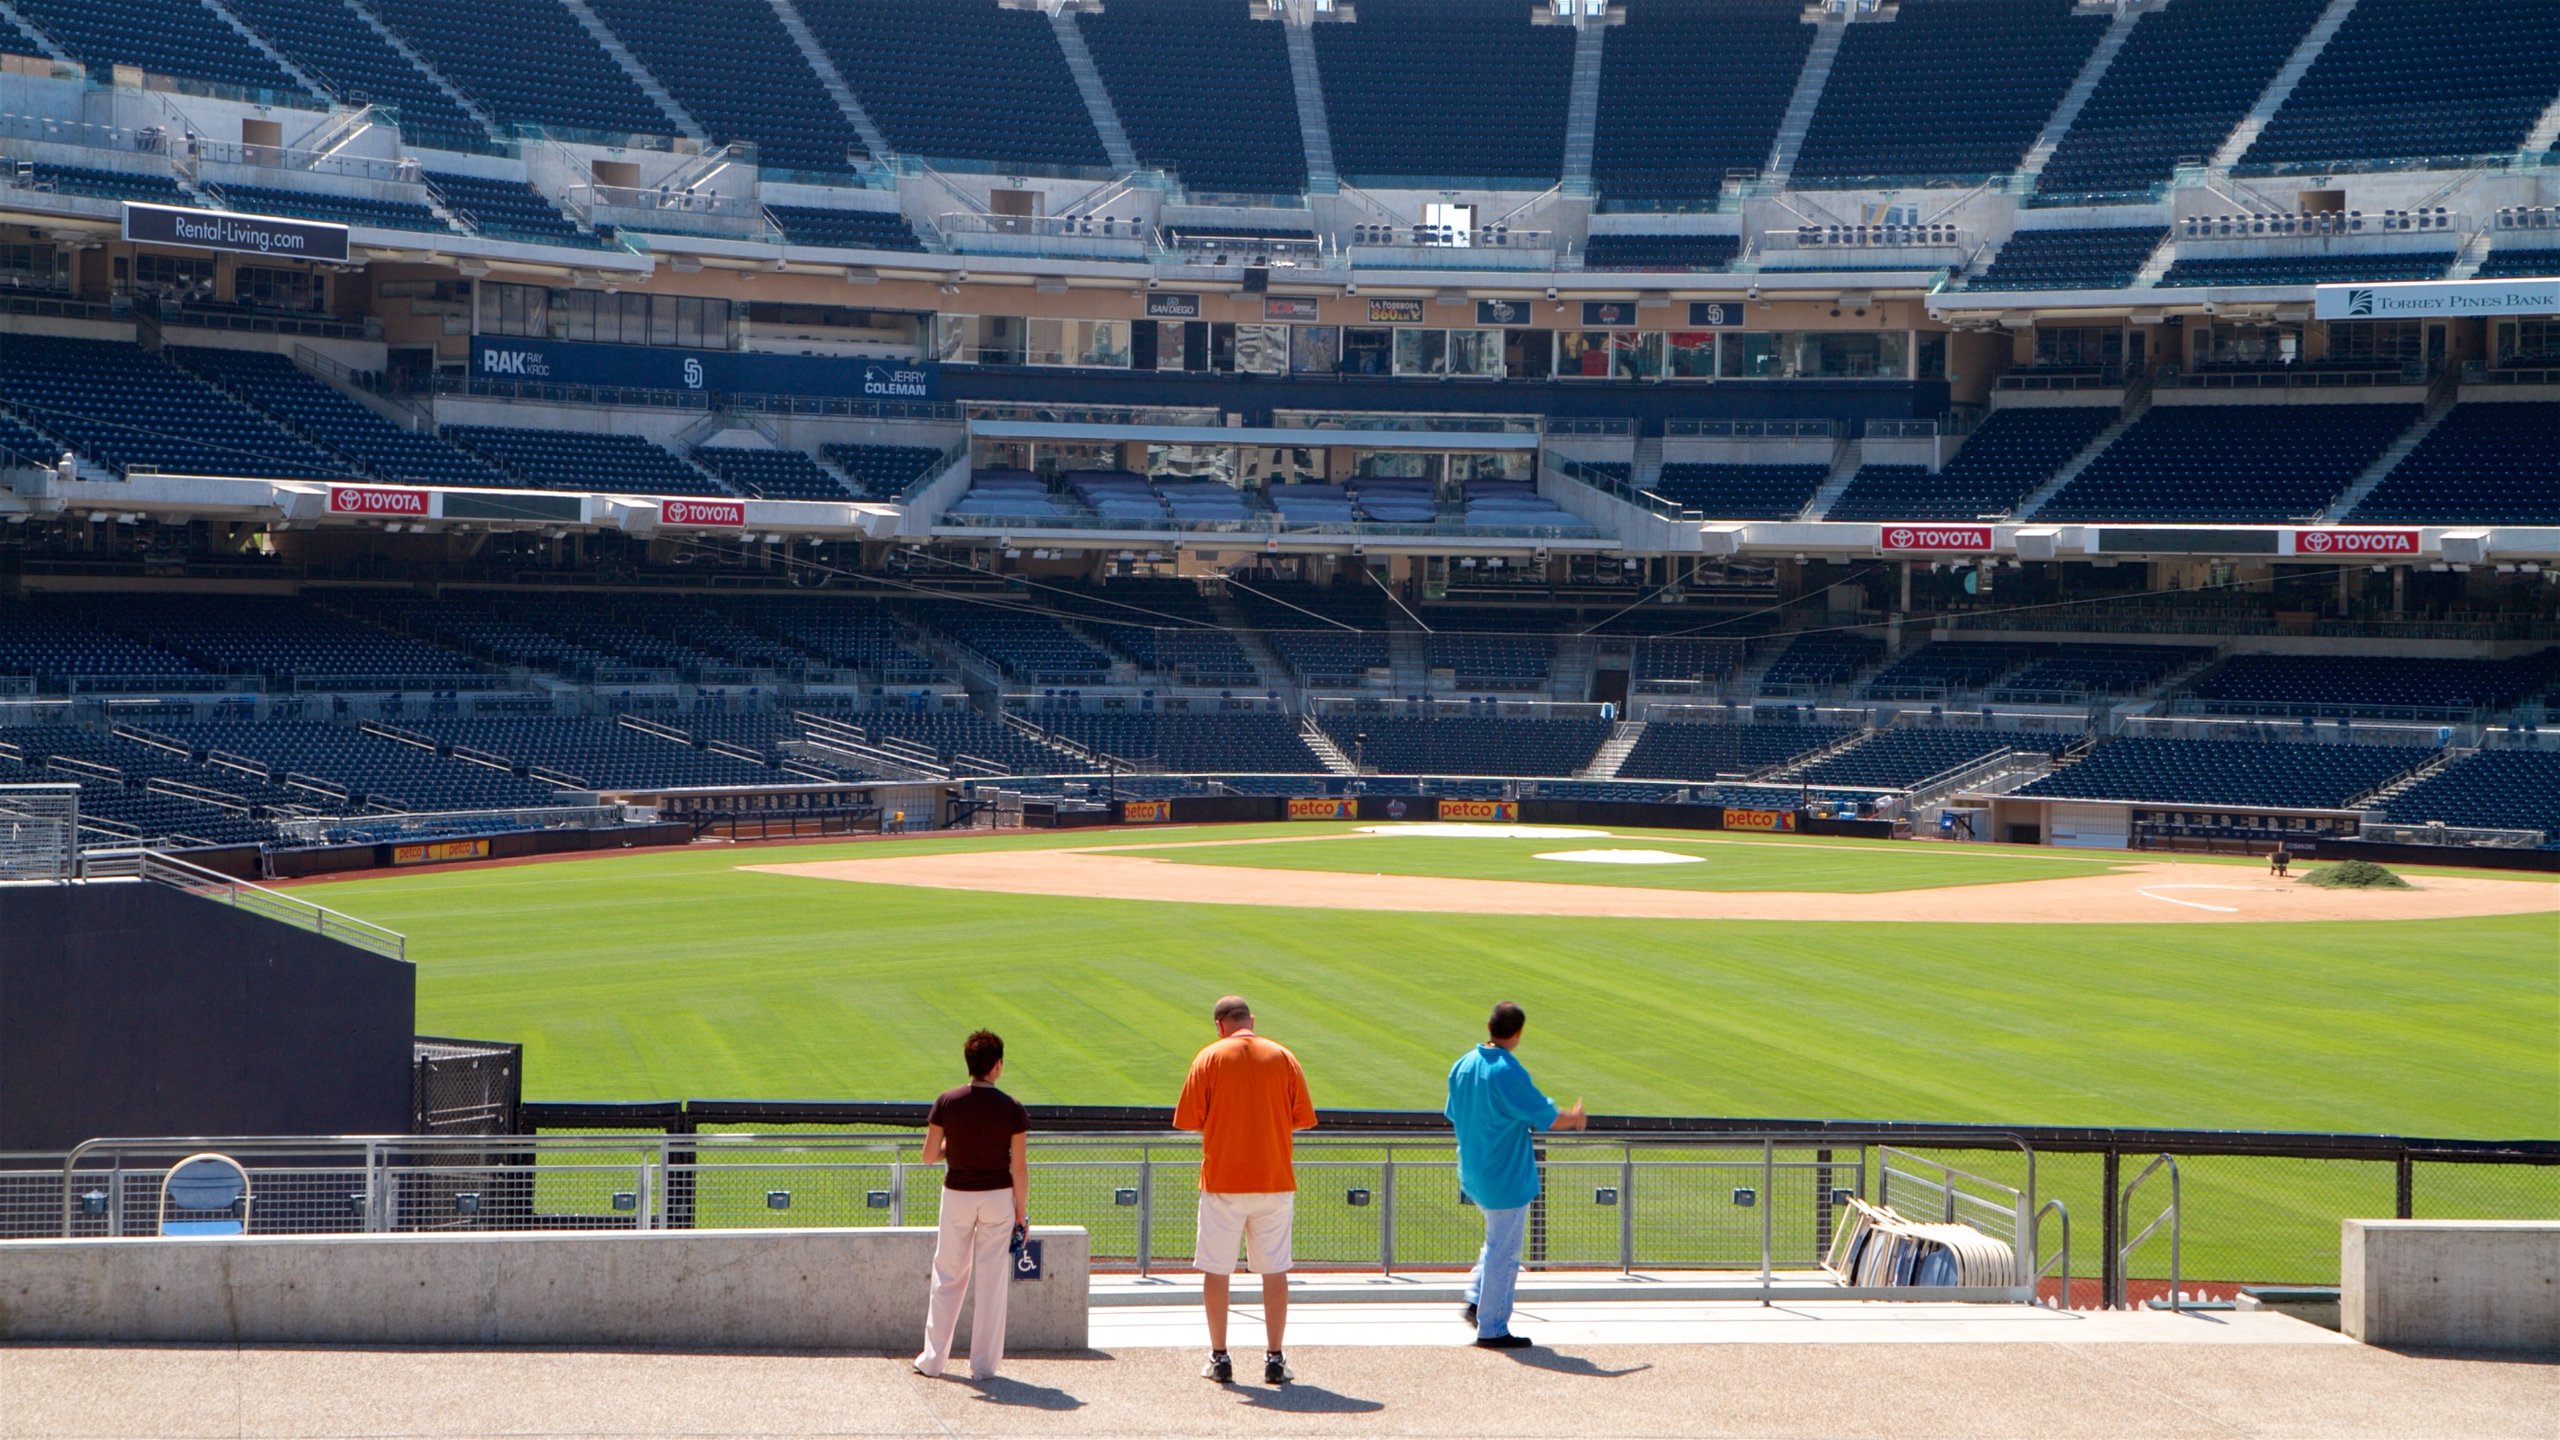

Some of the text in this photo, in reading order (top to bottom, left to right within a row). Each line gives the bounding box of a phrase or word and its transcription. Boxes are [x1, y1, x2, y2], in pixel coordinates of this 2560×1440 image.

[175, 216, 305, 251] Rental-Living.com
[2378, 293, 2555, 309] TORREY PINES BANK
[1150, 305, 1195, 315] SAN DIEGO
[484, 350, 526, 375] RAK
[526, 353, 543, 363] RAY
[527, 364, 550, 376] KROC
[890, 371, 926, 383] JERRY
[864, 382, 926, 396] COLEMAN
[363, 493, 421, 511] TOYOTA
[689, 505, 739, 522] TOYOTA
[1916, 531, 1984, 546] TOYOTA
[2334, 534, 2411, 550] TOYOTA
[1289, 800, 1334, 815] petco
[1440, 802, 1491, 818] petco
[1726, 811, 1772, 829] petco
[399, 847, 422, 860] petco
[448, 843, 471, 857] petco
